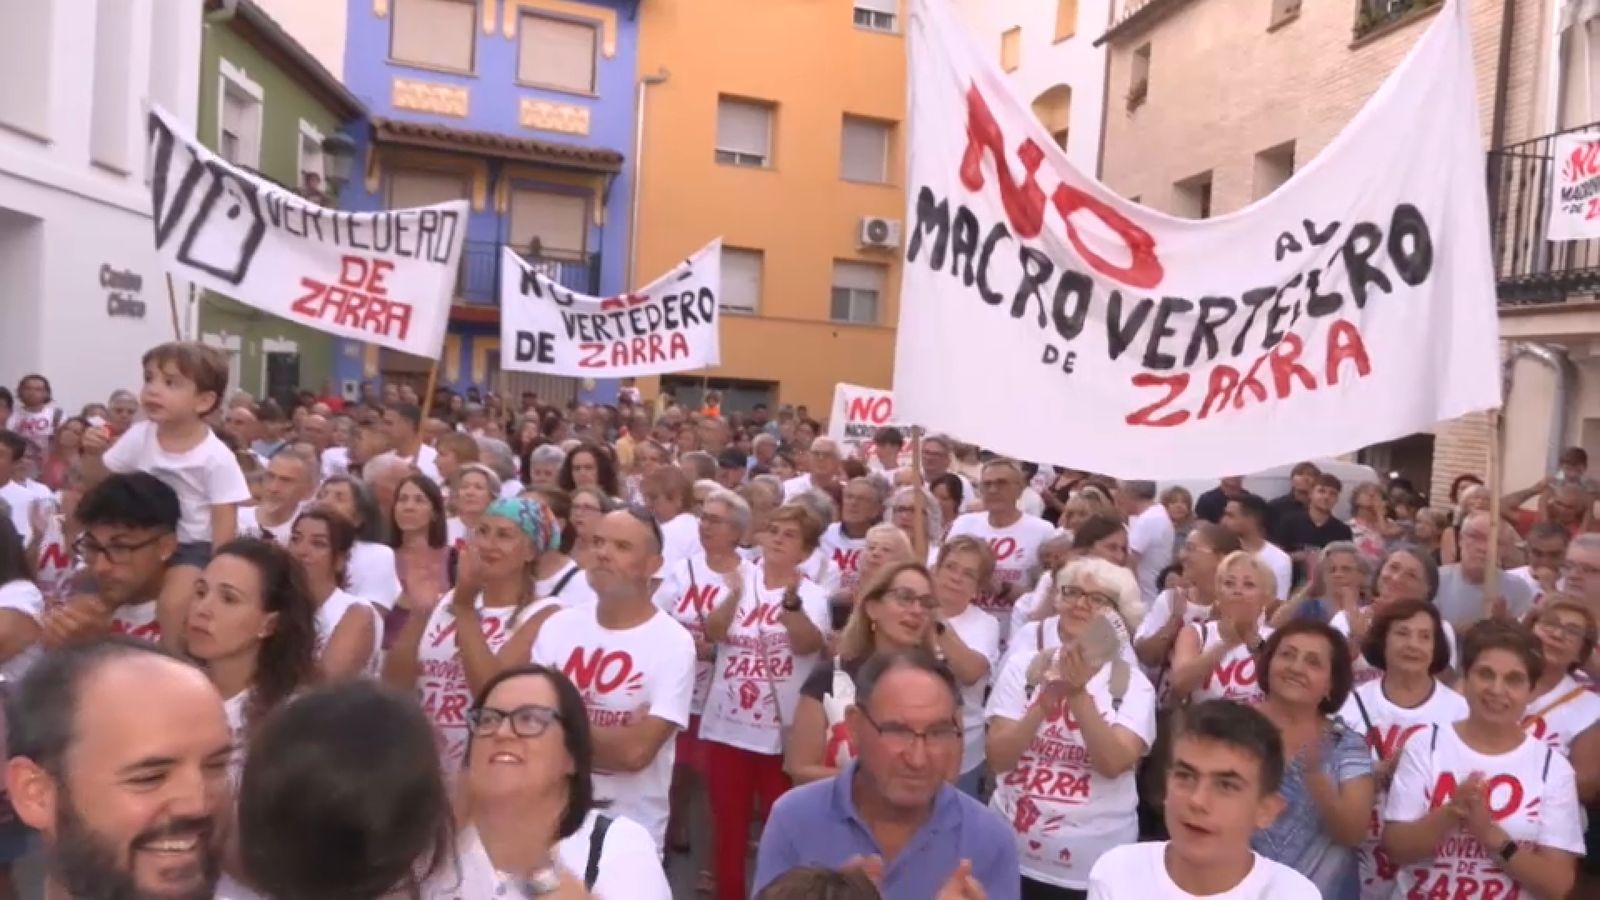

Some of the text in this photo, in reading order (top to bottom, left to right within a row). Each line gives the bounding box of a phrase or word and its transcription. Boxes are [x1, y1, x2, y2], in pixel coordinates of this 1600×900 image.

[960, 77, 1163, 289] NO
[1275, 218, 1341, 262] AL
[340, 254, 395, 295] DE
[907, 185, 1433, 370] MACRO VERTEERO
[291, 276, 413, 341] ZARRA
[561, 286, 714, 342] VERTEDERO
[514, 330, 690, 368] DE ZARRA
[1041, 319, 1371, 427] DE ZARRA
[849, 395, 893, 425] NO
[563, 646, 633, 694] NO
[723, 655, 794, 680] ZARRA
[1004, 765, 1093, 797] ARRA
[1456, 861, 1477, 875] DE
